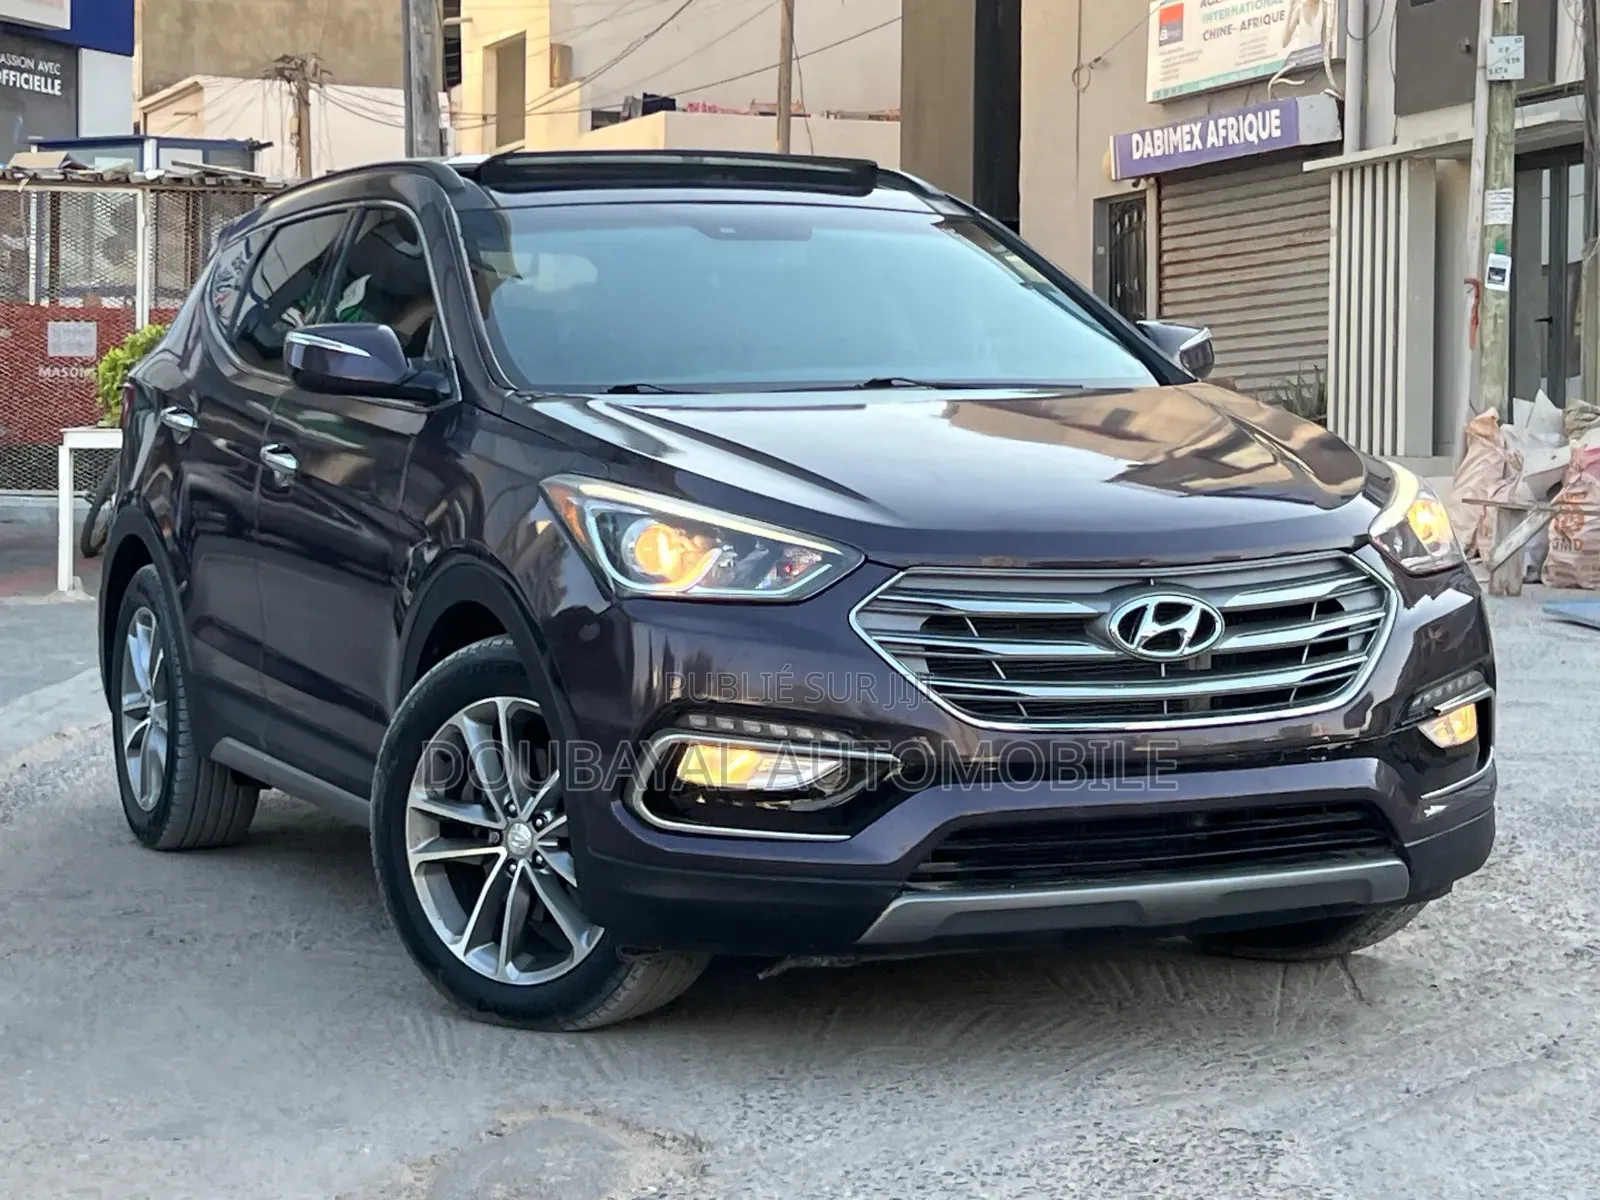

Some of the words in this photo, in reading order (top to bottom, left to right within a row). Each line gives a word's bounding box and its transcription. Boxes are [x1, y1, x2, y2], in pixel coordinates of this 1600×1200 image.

[1239, 10, 1286, 32] AFRIQUE
[37, 60, 61, 75] AVEC
[1131, 122, 1202, 160] DABIMEX
[1206, 108, 1282, 149] AFRIQUE
